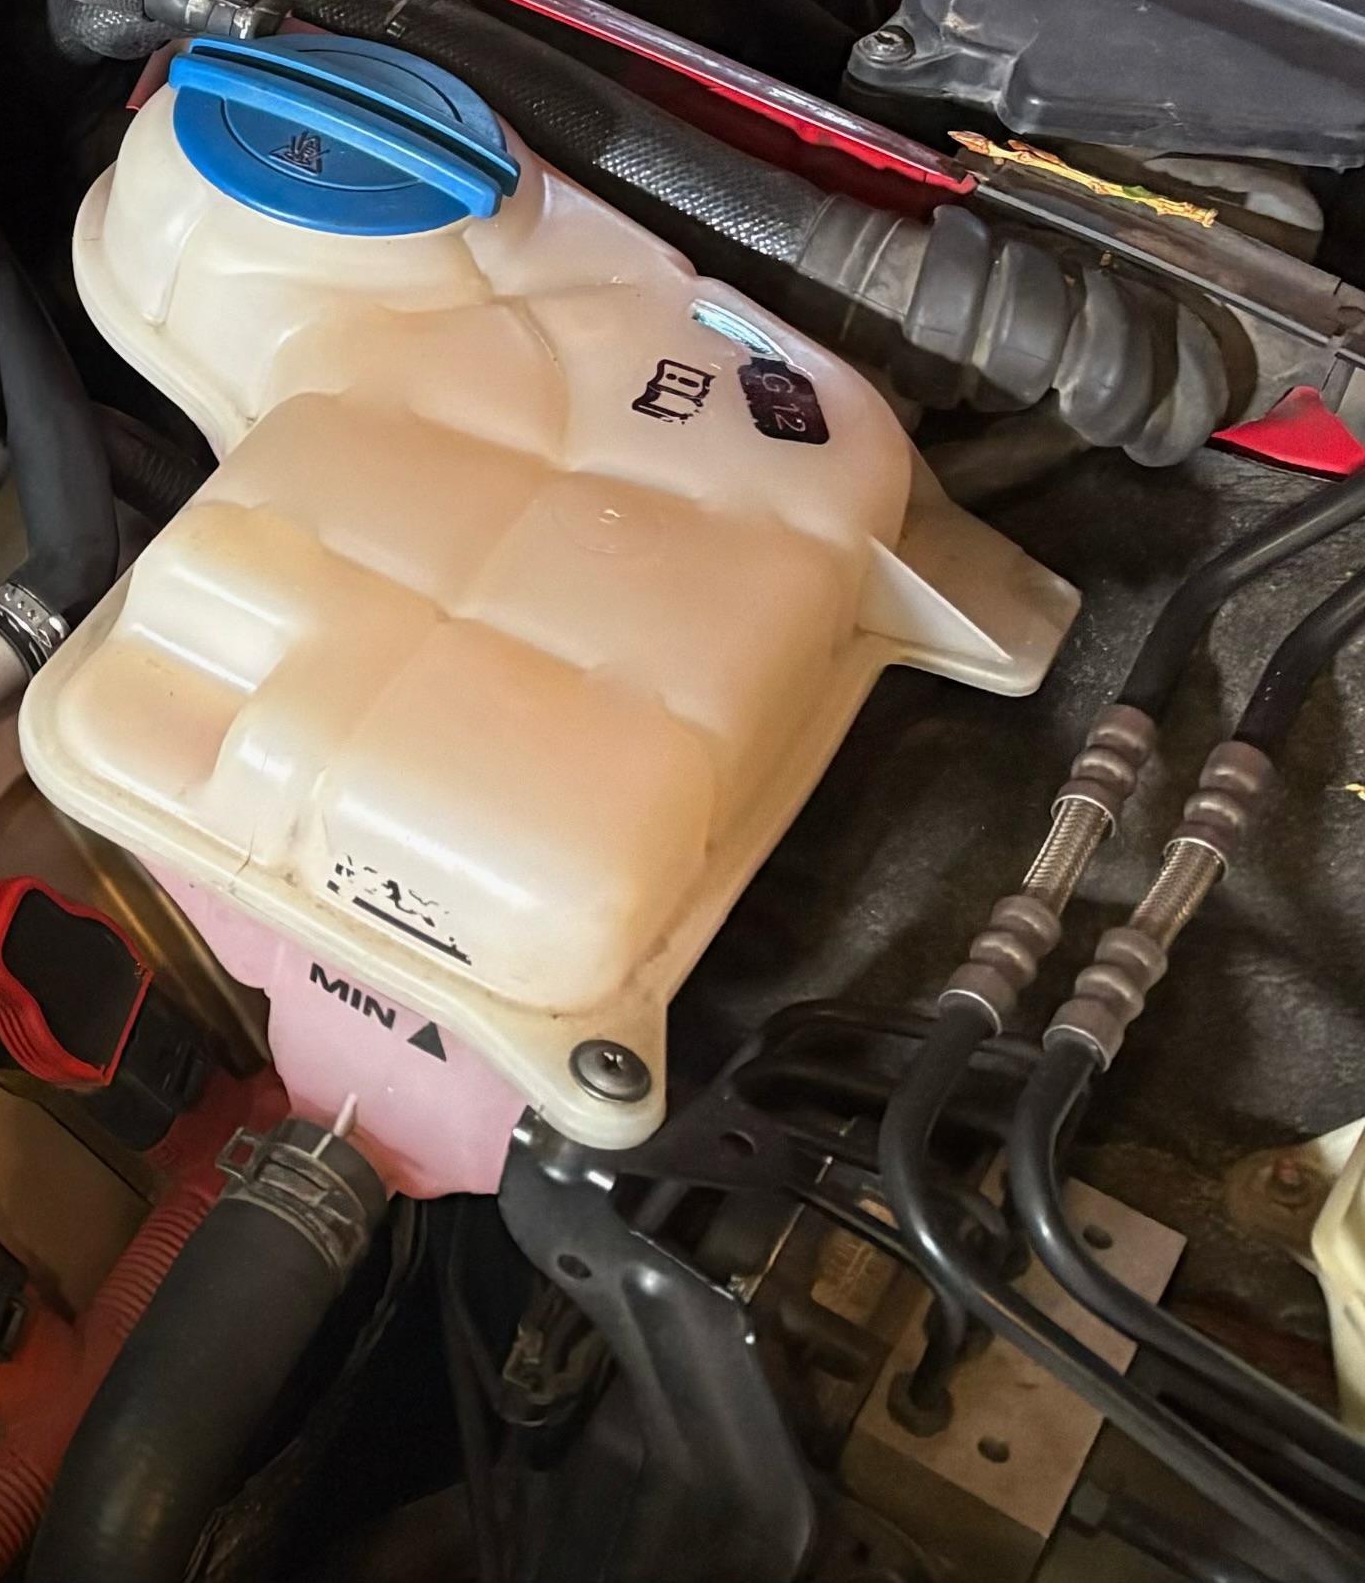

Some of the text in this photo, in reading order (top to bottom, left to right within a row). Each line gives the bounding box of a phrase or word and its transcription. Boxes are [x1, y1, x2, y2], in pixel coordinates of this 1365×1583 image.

[762, 372, 806, 432] G 12
[309, 962, 396, 1030] MIN
